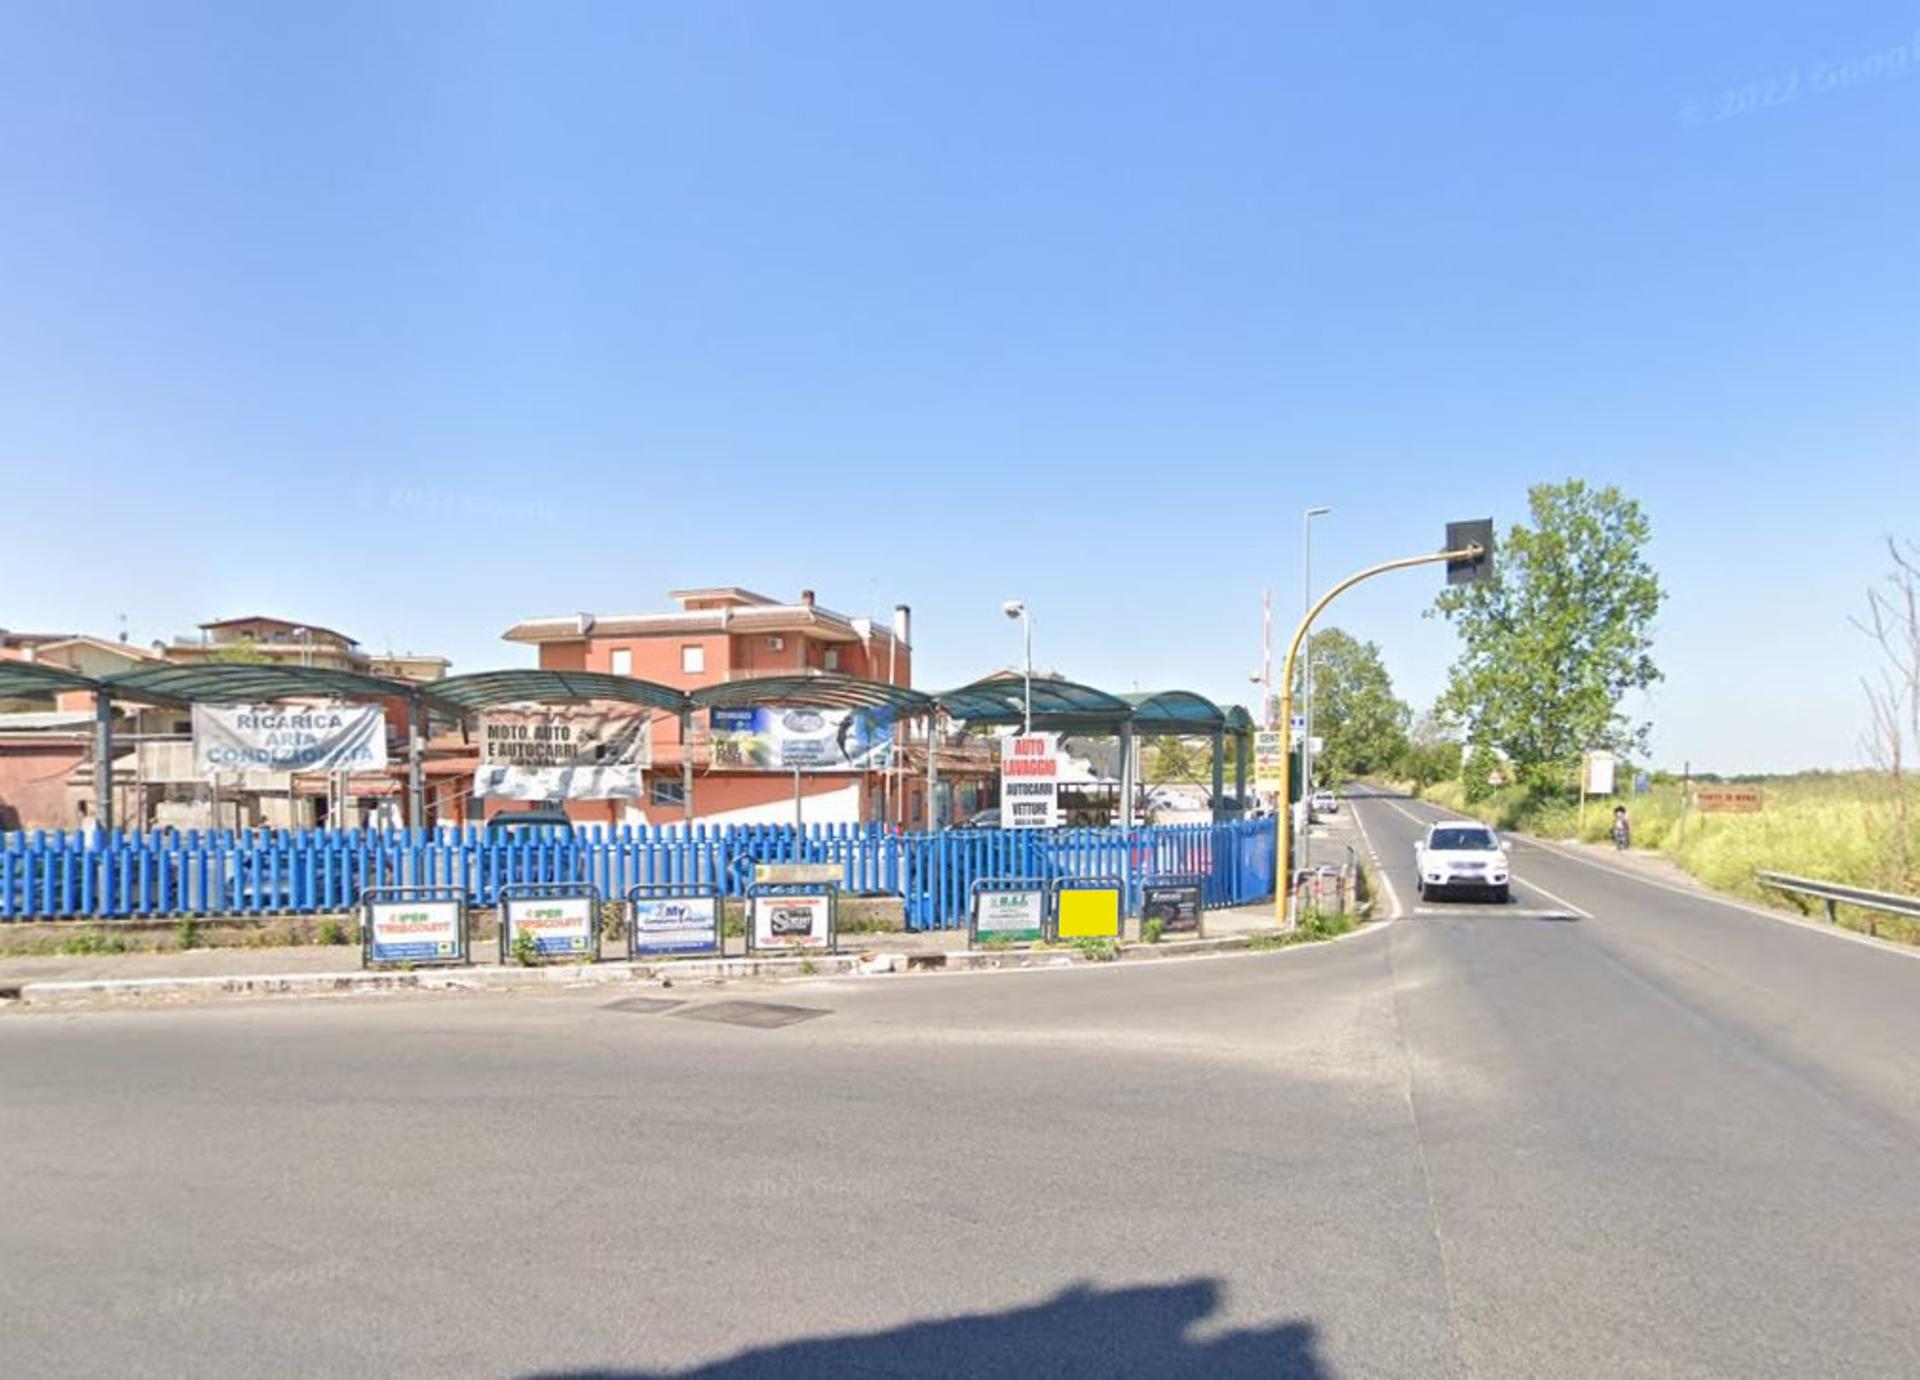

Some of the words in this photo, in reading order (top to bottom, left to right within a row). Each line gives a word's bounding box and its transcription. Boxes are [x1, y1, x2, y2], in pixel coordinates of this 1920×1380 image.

[237, 714, 343, 730] RICARICA
[265, 730, 317, 746] ARIA
[534, 725, 570, 741] AUTO
[488, 742, 496, 757] E
[500, 742, 579, 759] AUTOCARRI
[1015, 739, 1044, 755] AUTO
[1004, 760, 1056, 776] LAVAGGIO
[1006, 783, 1053, 796] AUTOCARRI
[1012, 802, 1048, 816] VETTURE
